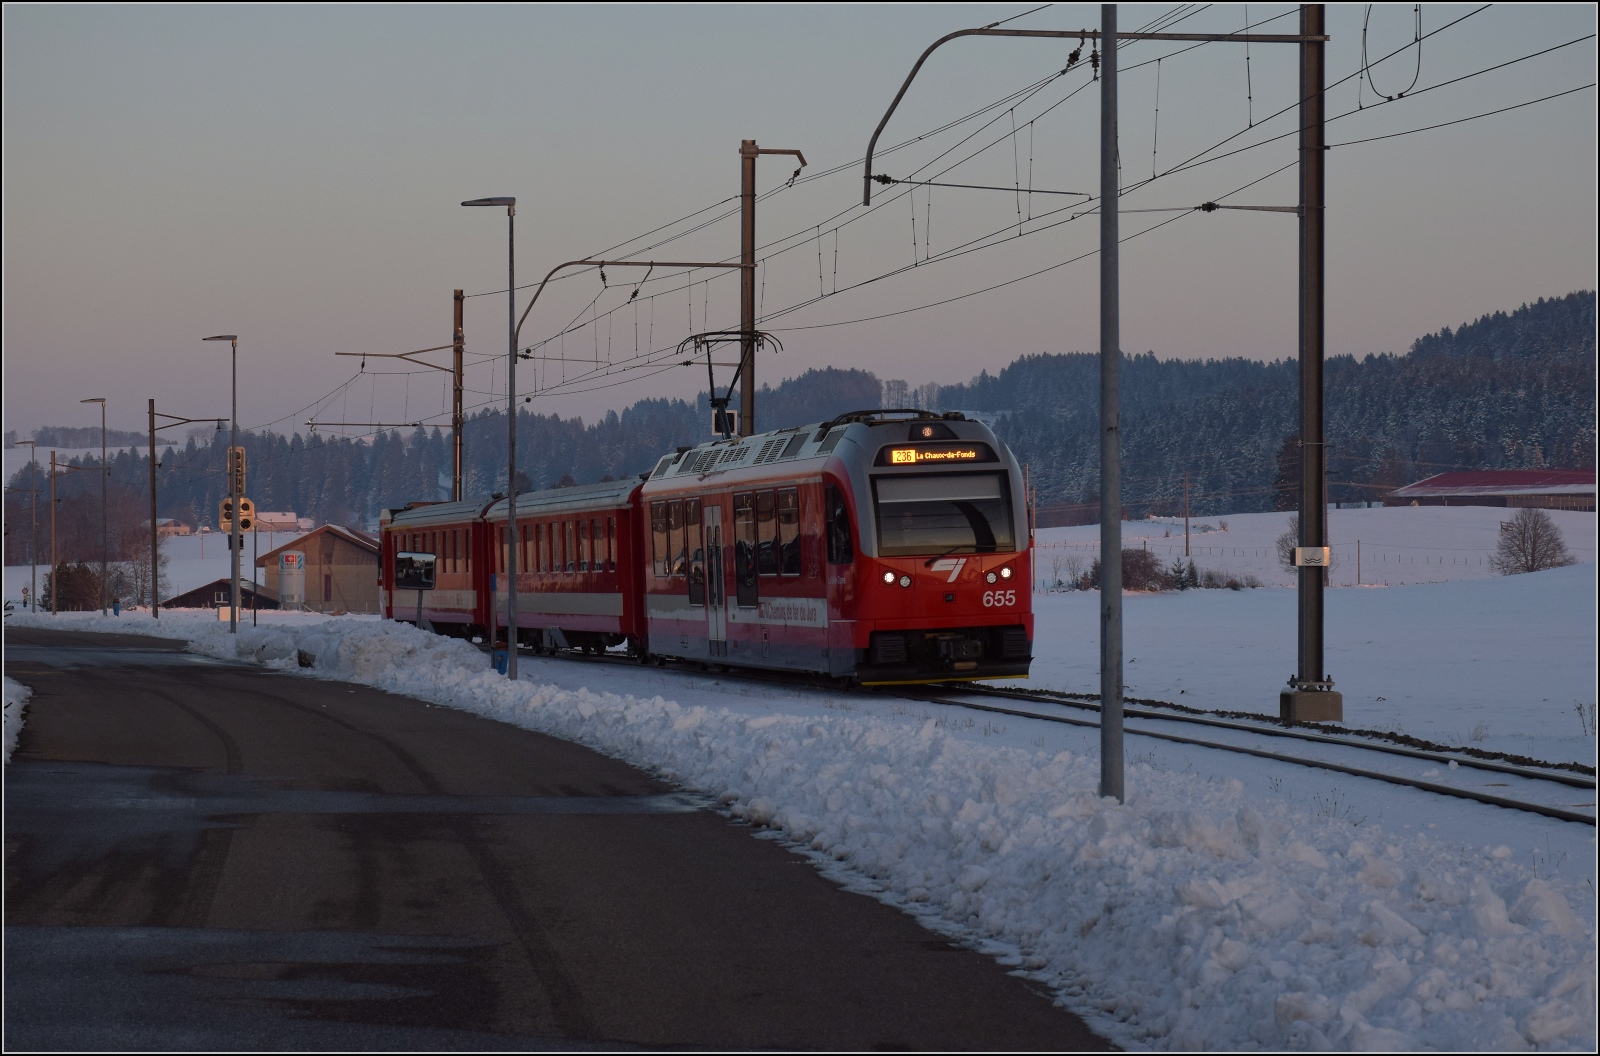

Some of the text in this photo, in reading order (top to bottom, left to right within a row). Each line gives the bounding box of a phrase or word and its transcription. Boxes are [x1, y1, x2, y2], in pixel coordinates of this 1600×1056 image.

[896, 451, 912, 462] 236
[925, 450, 976, 459] Chaux-de-Fonds
[982, 590, 1016, 608] 655
[768, 602, 786, 621] Chemins
[787, 603, 792, 621] de
[807, 604, 817, 622] Jura
